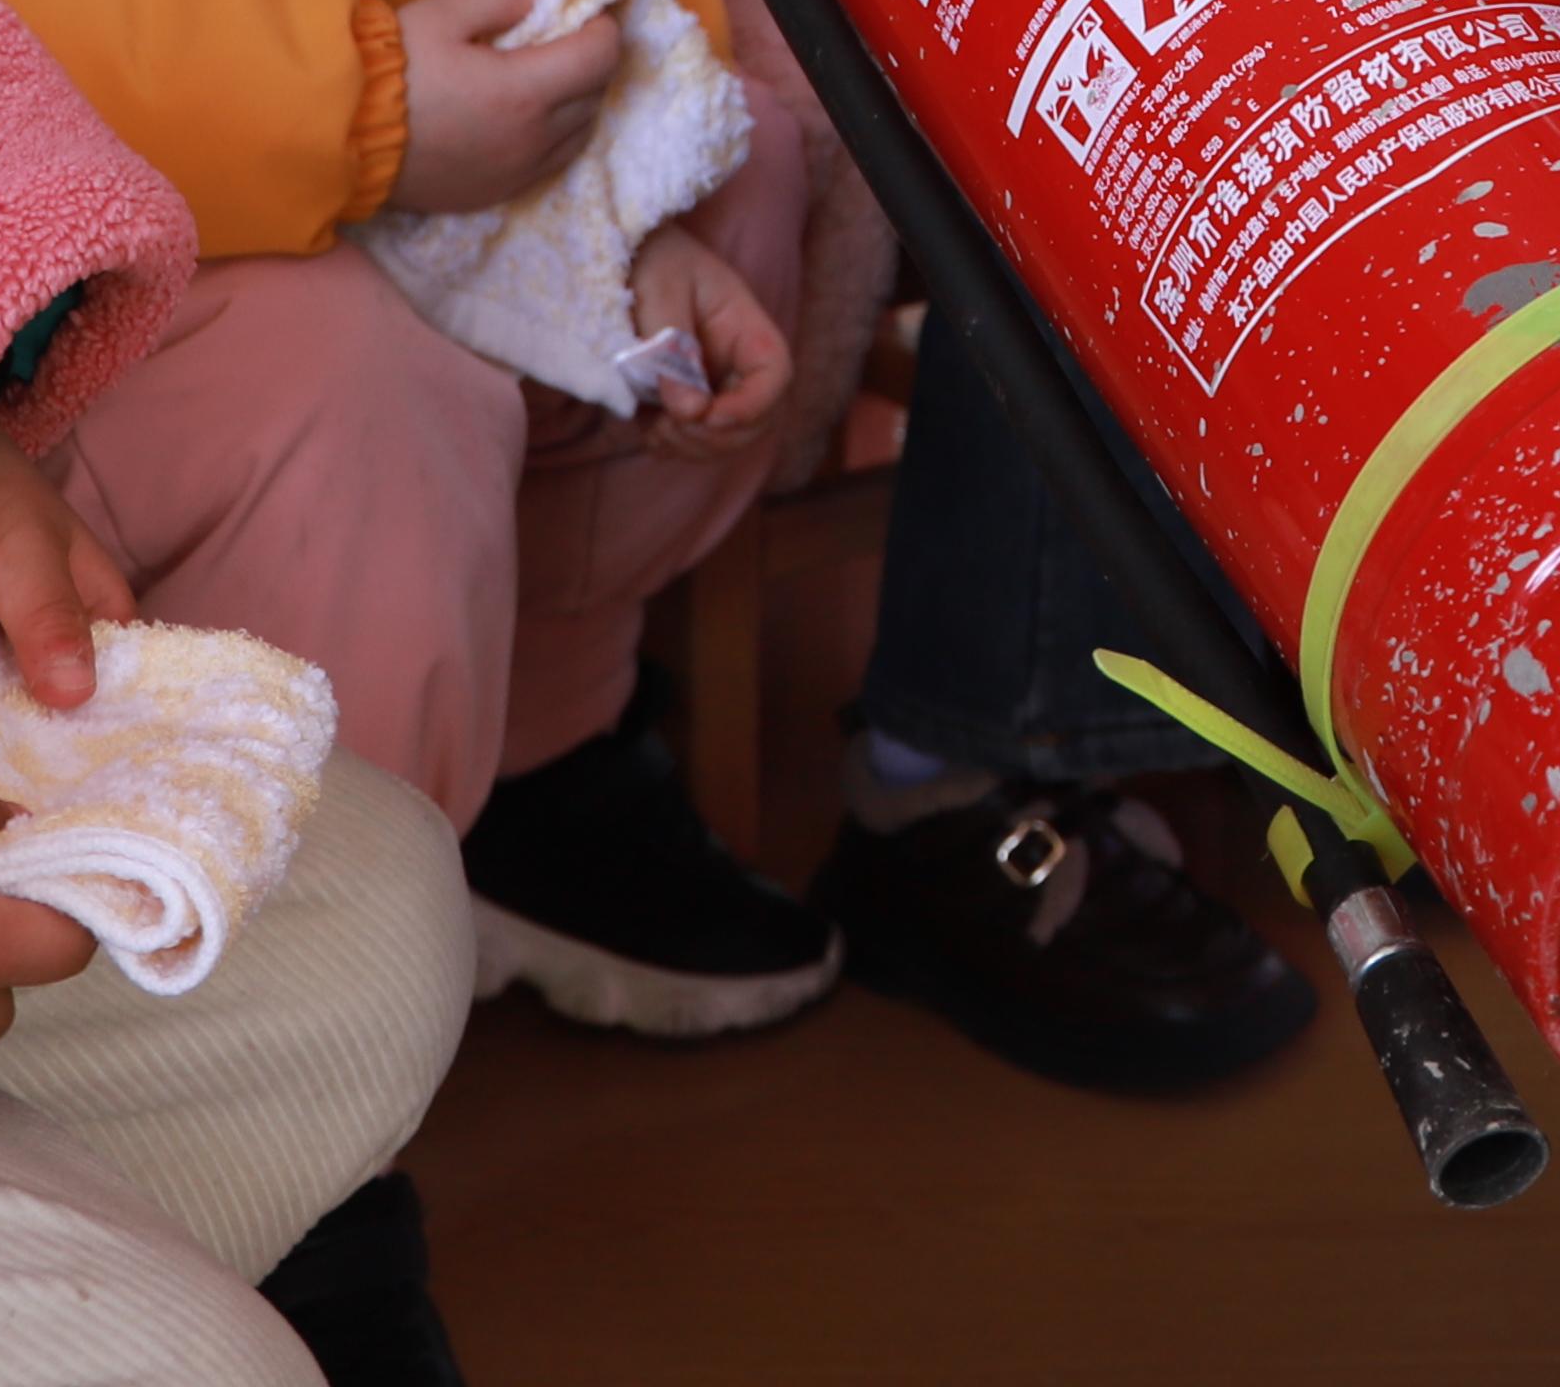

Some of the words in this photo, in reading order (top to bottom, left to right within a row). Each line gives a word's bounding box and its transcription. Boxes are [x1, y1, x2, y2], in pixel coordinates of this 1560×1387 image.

[1153, 14, 1539, 325] 徐州市淮海消防器材有限公司
